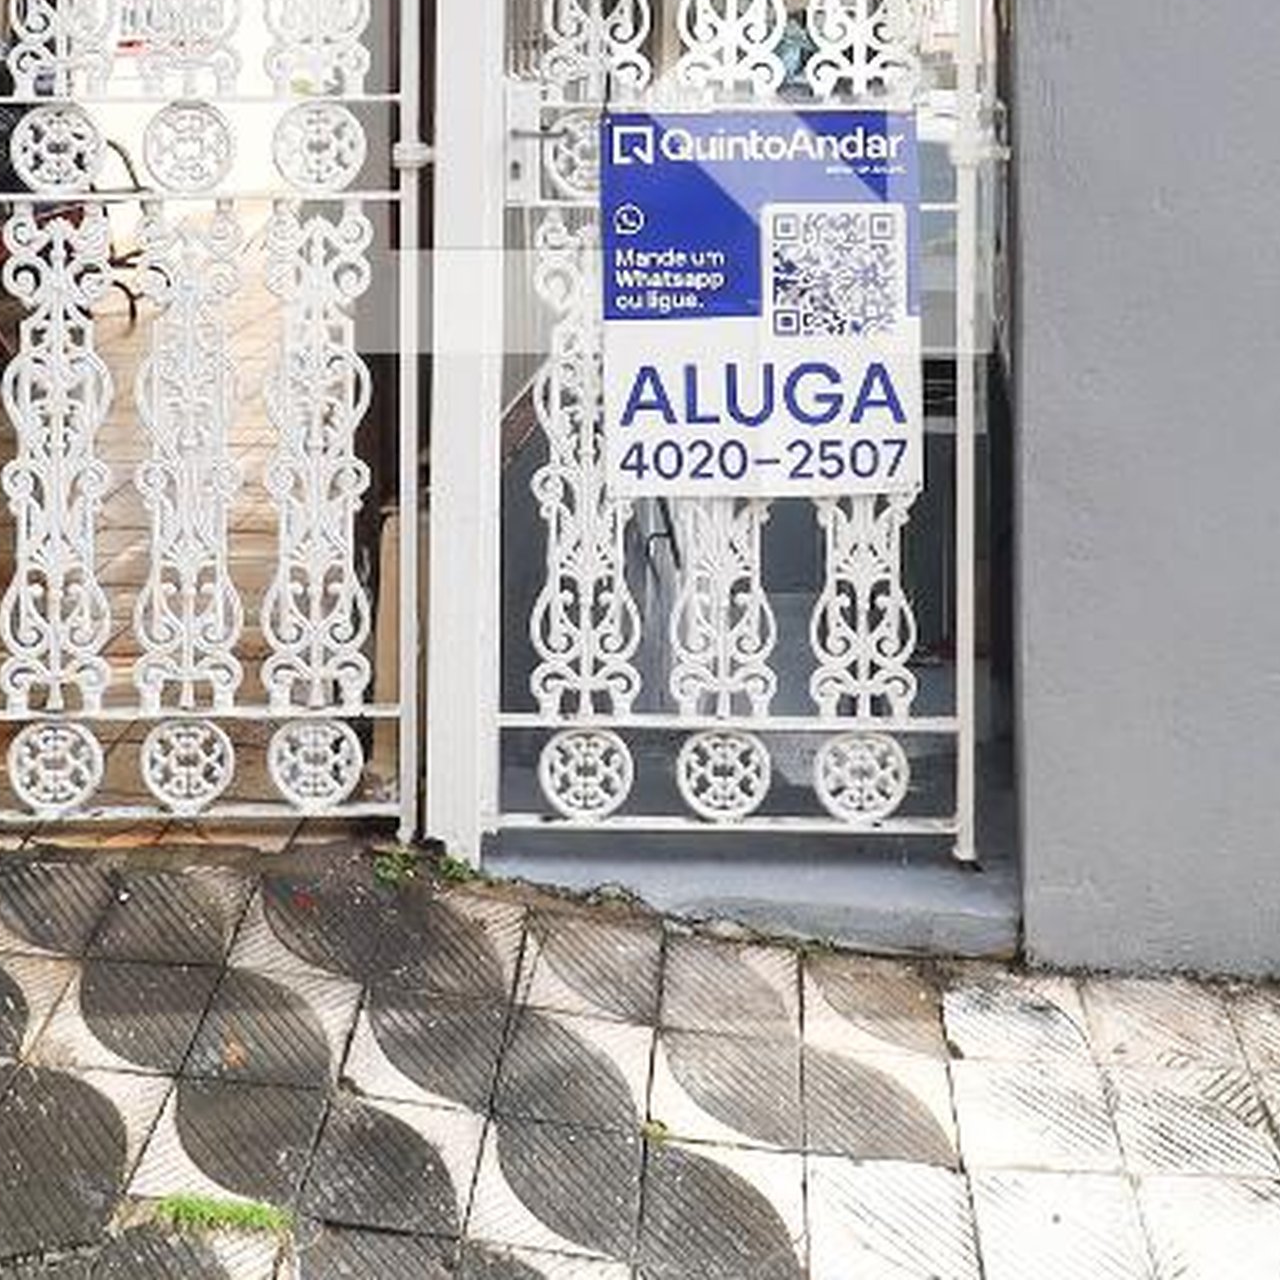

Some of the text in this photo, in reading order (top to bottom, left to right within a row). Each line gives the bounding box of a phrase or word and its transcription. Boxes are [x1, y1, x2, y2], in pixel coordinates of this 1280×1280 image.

[660, 126, 904, 160] QuintoAndar
[615, 248, 725, 268] Mande um
[615, 295, 643, 310] ou
[619, 362, 908, 427] ALUGA
[619, 439, 908, 481] 4020-2507
